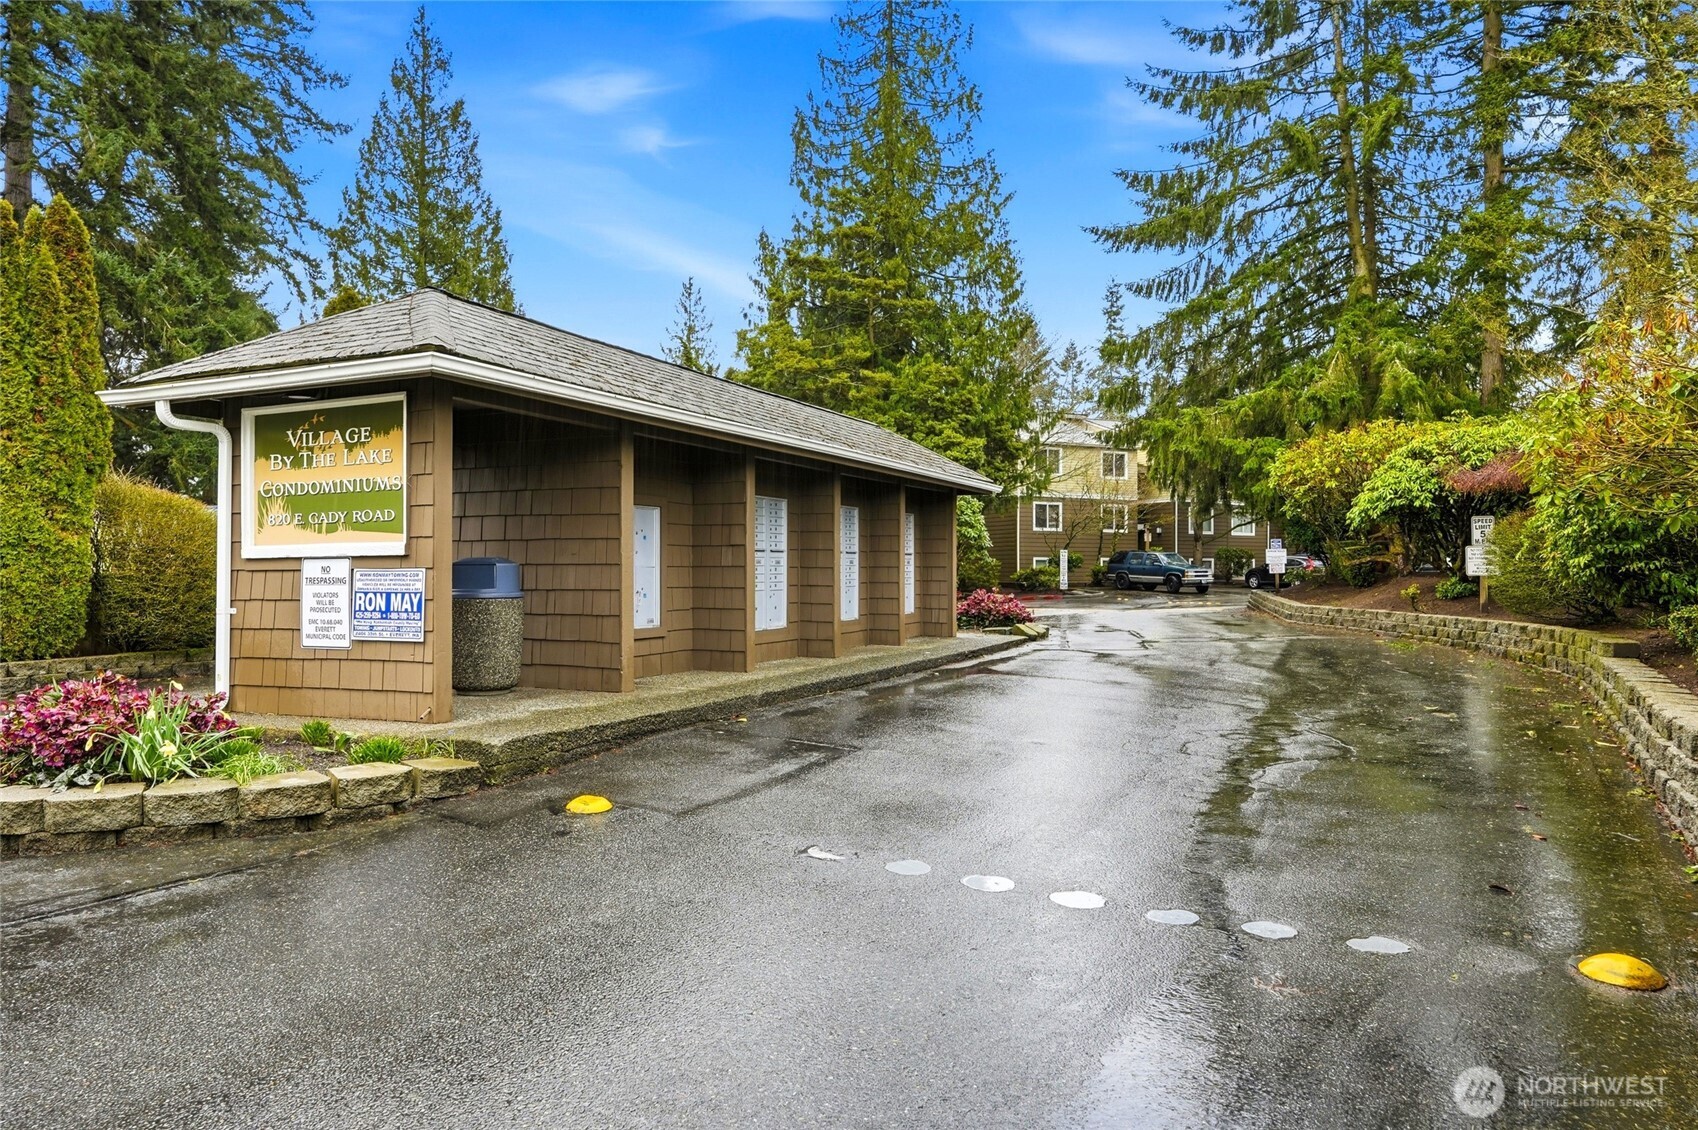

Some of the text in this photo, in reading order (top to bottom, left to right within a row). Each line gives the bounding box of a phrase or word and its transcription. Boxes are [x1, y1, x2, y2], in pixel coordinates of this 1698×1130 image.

[260, 476, 402, 498] CONDOMINIUMS
[267, 514, 291, 526] 820
[294, 514, 305, 525] E.
[352, 508, 395, 523] ROAD
[1480, 530, 1486, 538] 5
[320, 565, 331, 573] NO
[305, 577, 347, 585] TRESPASSING
[355, 592, 421, 612] RON MAY
